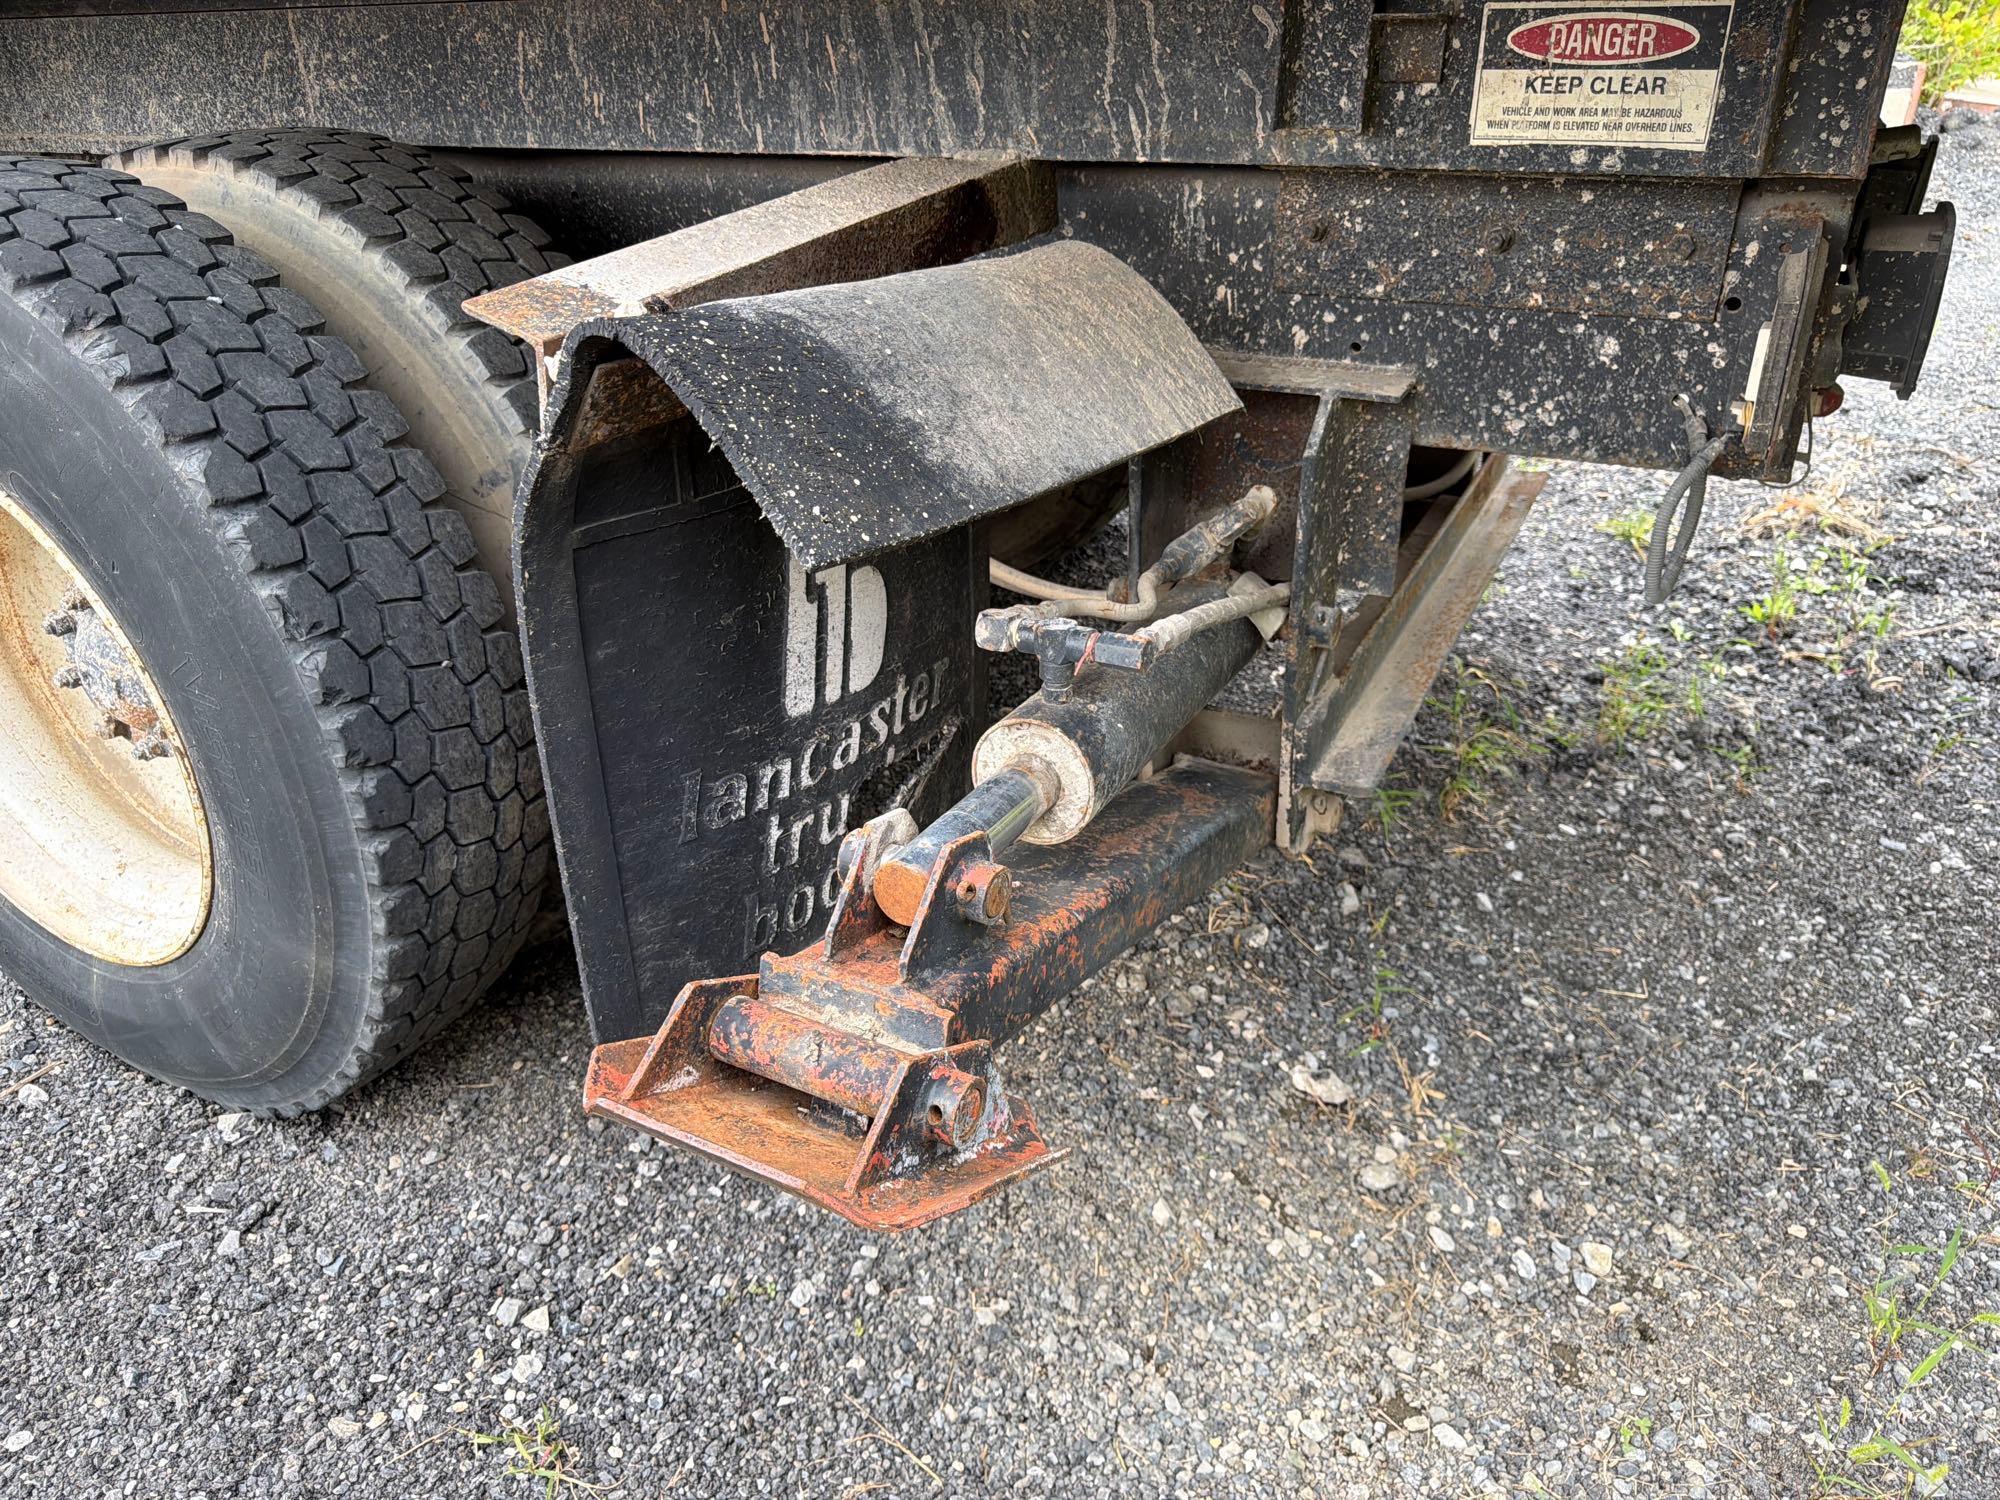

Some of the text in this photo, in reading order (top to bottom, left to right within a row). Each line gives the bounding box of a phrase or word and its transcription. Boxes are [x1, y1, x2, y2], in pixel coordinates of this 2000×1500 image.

[1549, 22, 1658, 57] DANGER
[1524, 76, 1667, 95] KEEP CLEAR
[1502, 106, 1532, 117] VEHICLE
[1534, 107, 1550, 117] AND
[1553, 107, 1576, 117] WORK
[1578, 107, 1598, 117] AREA
[1621, 108, 1632, 118] BE
[1634, 108, 1683, 119] HAZARDOUS
[1487, 120, 1509, 130] WHEN
[1553, 121, 1560, 130] IS
[1563, 121, 1600, 131] ELEVATED
[1602, 121, 1623, 132] NEAR
[1625, 122, 1667, 132] OVERHEAD
[1669, 123, 1695, 133] LINES.
[678, 656, 950, 845] lancaster
